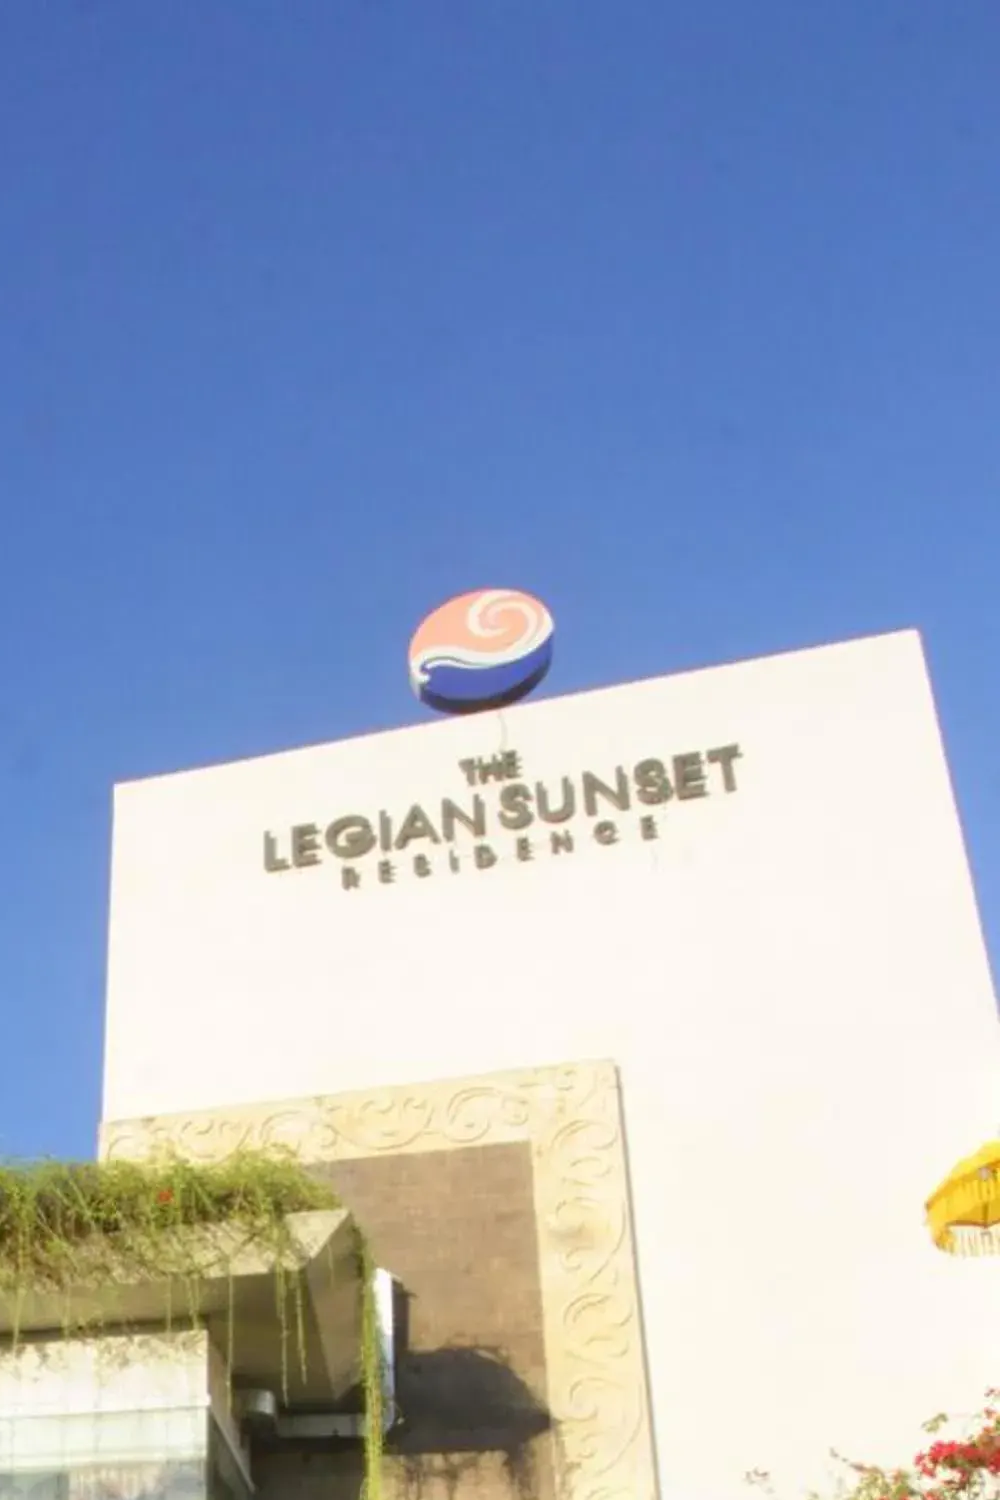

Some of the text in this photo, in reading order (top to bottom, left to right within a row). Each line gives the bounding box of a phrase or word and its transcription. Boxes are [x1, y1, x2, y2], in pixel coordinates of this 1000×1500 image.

[458, 749, 523, 787] THE
[264, 743, 743, 874] LEGIAN SUNSET
[341, 814, 660, 891] RESIDENCE
